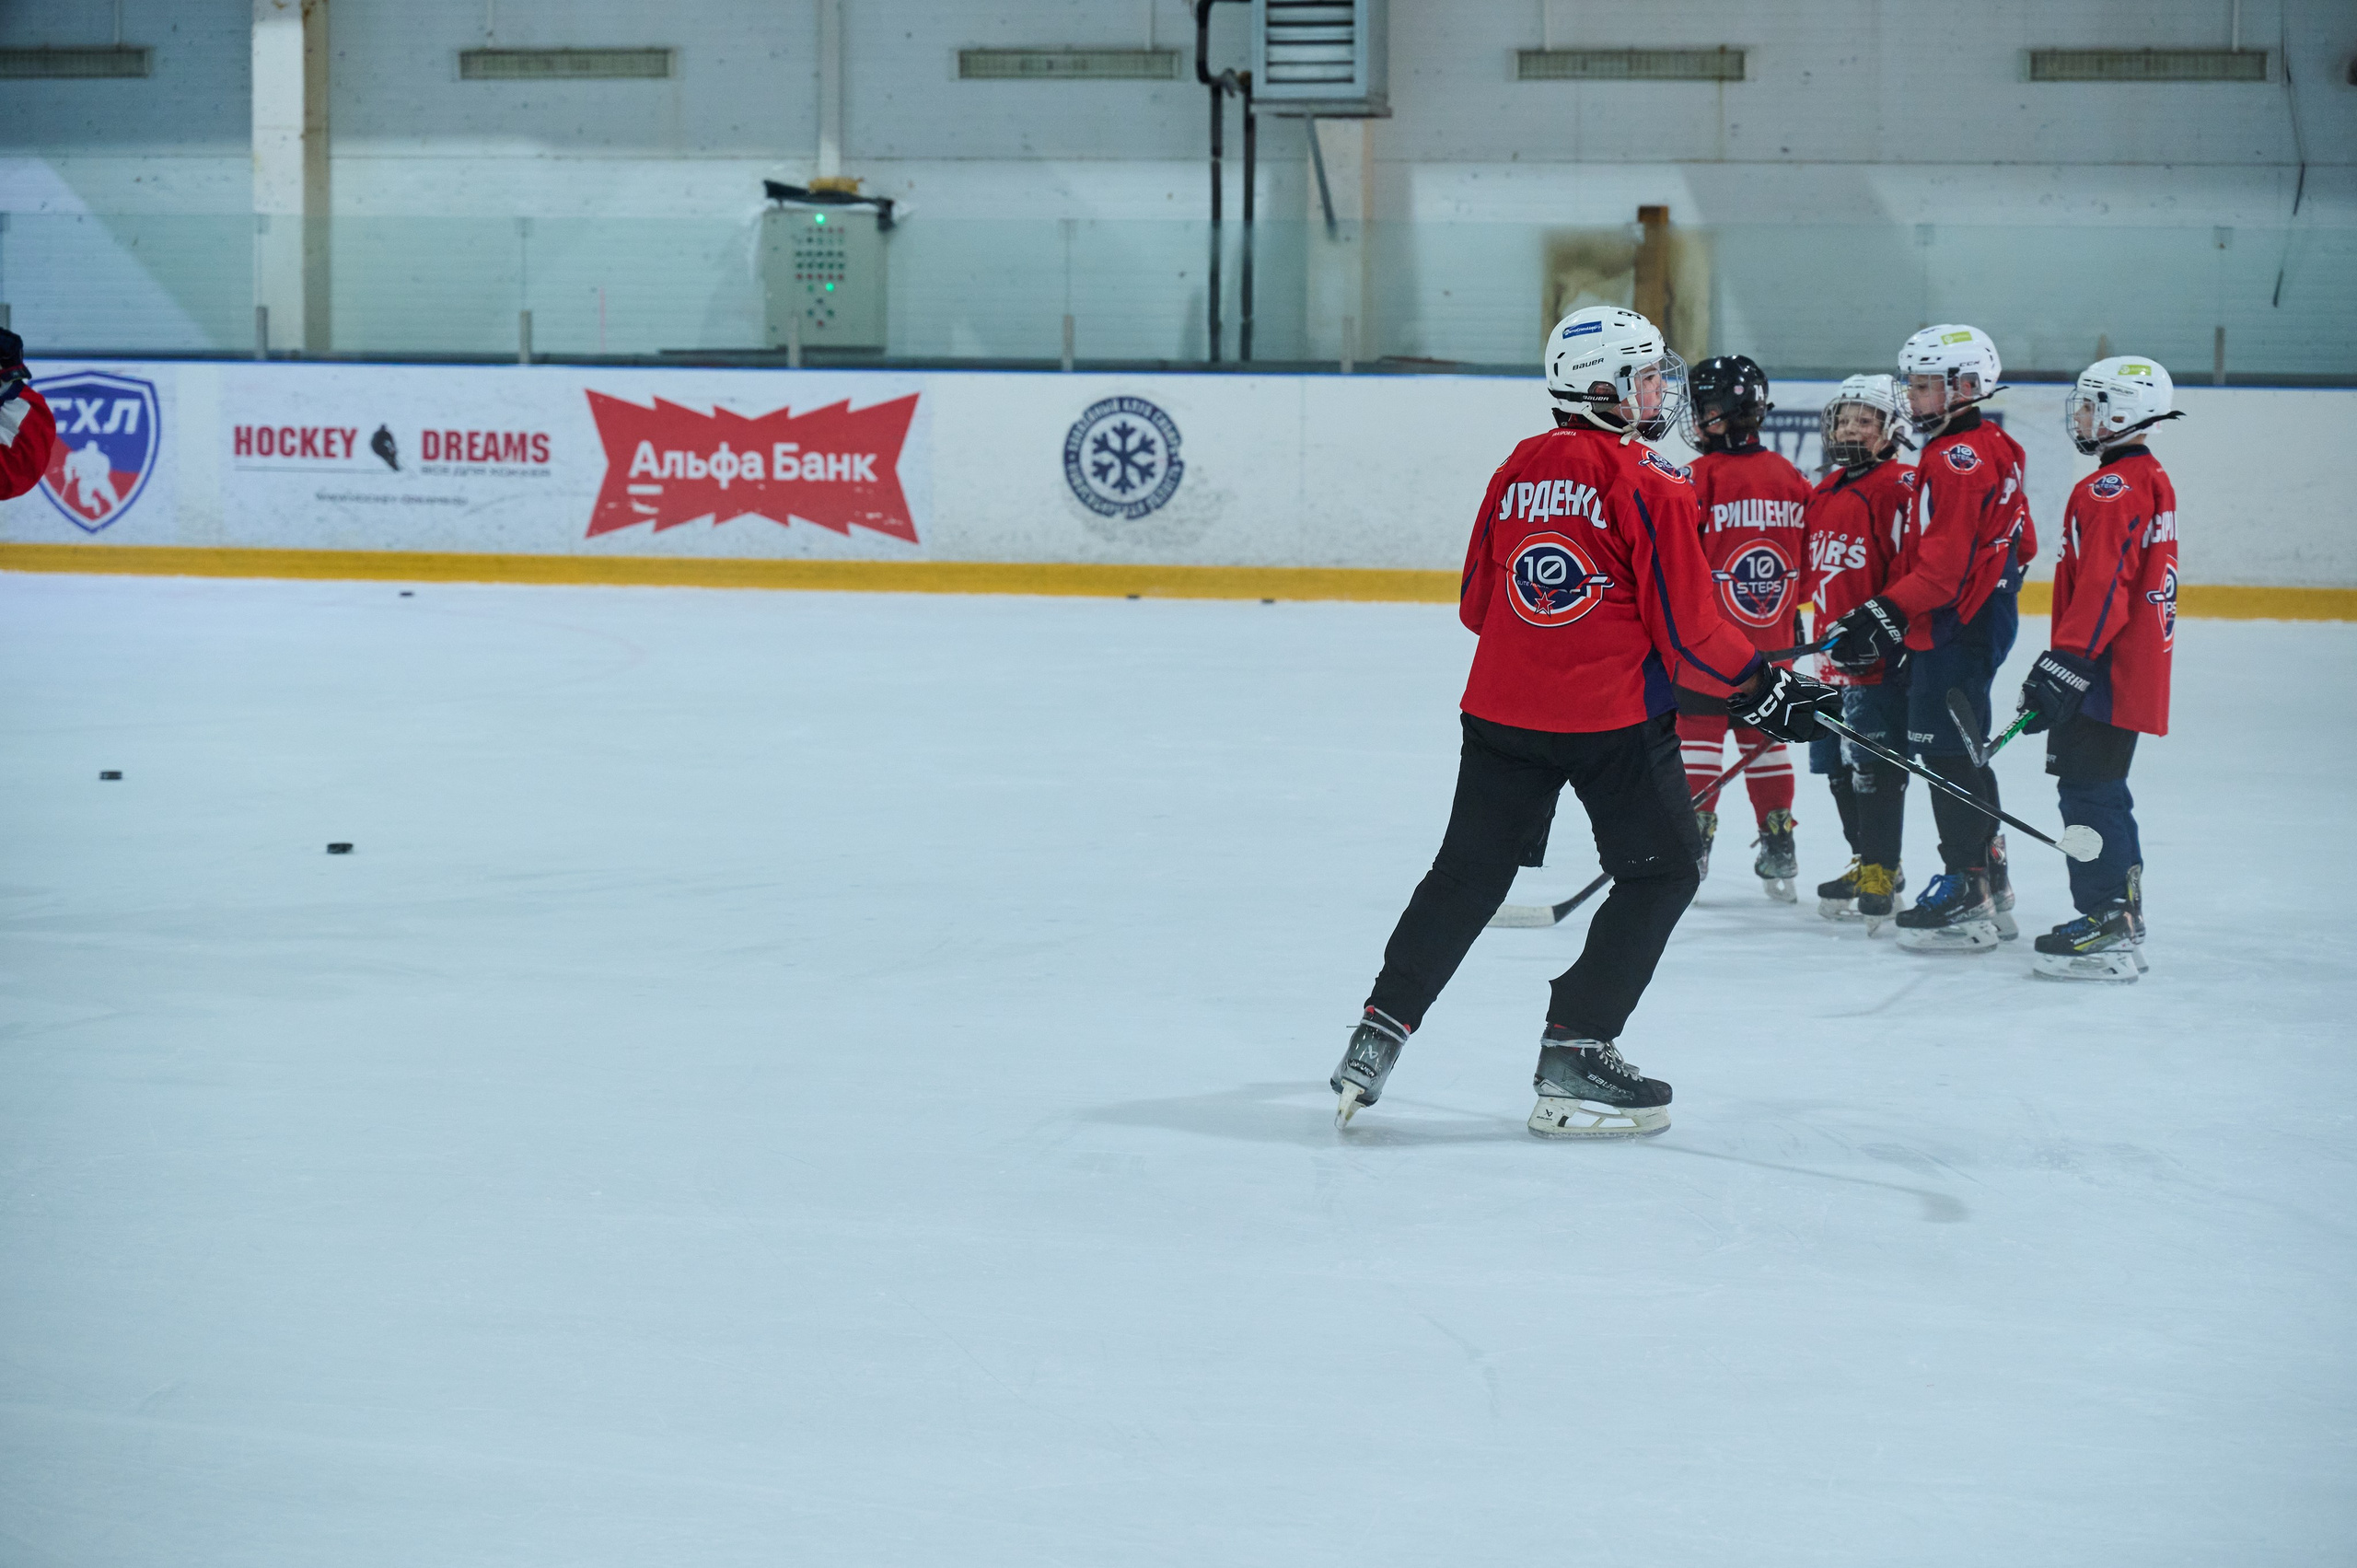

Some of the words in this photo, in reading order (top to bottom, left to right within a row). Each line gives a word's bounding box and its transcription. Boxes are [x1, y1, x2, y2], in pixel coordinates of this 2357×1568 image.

[1573, 357, 1604, 370] BAUER
[46, 397, 142, 435] СХЛ
[234, 425, 358, 459] HOCKEY
[421, 429, 551, 463] DREAMS
[628, 439, 765, 490] Альфа
[772, 442, 877, 482] Банк
[1704, 498, 1805, 533] РИЩЕНКО
[1524, 555, 1567, 585] 10
[1747, 556, 1774, 579] 10
[1736, 581, 1782, 594] STEPS
[1864, 599, 1903, 645] BAUER
[1743, 668, 1792, 726] CCM
